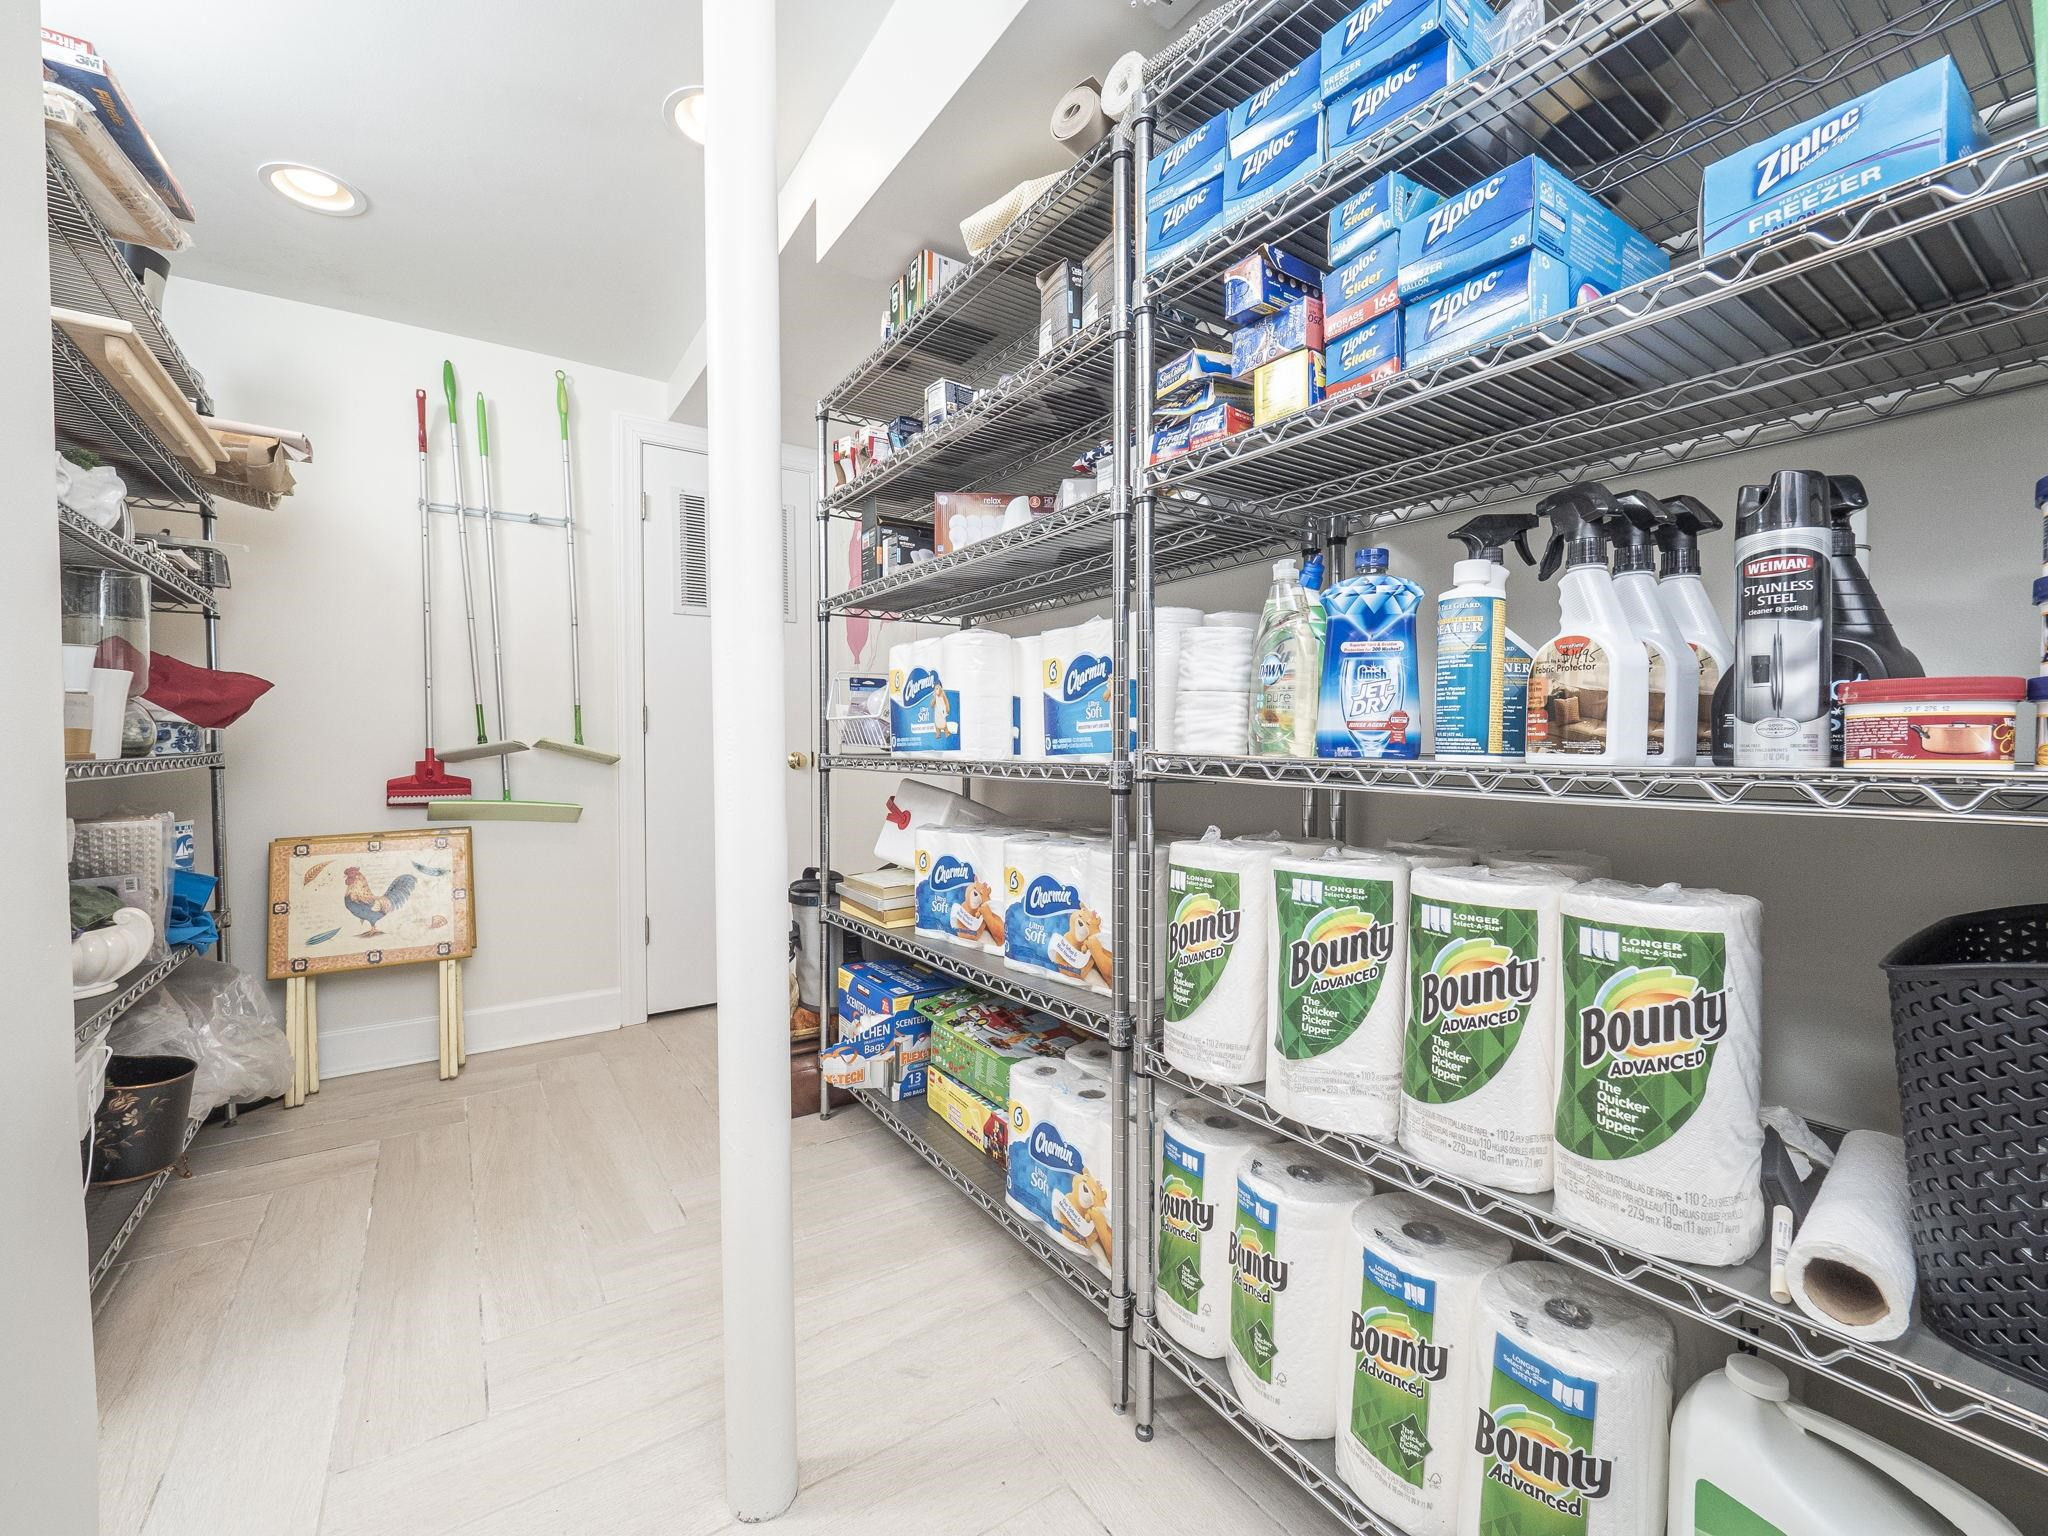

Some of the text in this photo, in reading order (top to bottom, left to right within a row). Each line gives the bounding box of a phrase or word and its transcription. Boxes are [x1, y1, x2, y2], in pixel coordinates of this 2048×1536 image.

[75, 53, 100, 70] 3M
[1324, 59, 1361, 89] FREEZER
[1351, 63, 1418, 128] Ziploc
[1161, 125, 1211, 176] Ziploc
[1240, 130, 1298, 184] Ziploc
[1757, 105, 1862, 196] Ziploc
[1799, 124, 1861, 172] Double Zipper
[1778, 172, 1846, 207] HEAVY DUTY
[1341, 185, 1376, 218] Ziploc
[1749, 165, 1883, 235] FREEZER
[1161, 187, 1211, 234] Ziploc
[1343, 202, 1378, 231] Slider
[1426, 177, 1503, 245] Ziploc
[1509, 233, 1526, 249] 38
[1340, 249, 1378, 288] Ziploc
[1344, 268, 1384, 300] Slider
[1401, 277, 1429, 293] GALLON
[1373, 289, 1397, 310] 166
[1427, 270, 1500, 335] Ziploc
[1326, 307, 1365, 334] STORAGE
[1341, 324, 1378, 361] Ziploc
[1343, 343, 1380, 371] Slider
[983, 496, 1002, 505] relax
[1747, 557, 1809, 576] WEIMAN
[1744, 579, 1814, 597] STAINLESS
[1757, 592, 1798, 606] STEEL
[1748, 604, 1809, 616] cleaner & polish
[1048, 664, 1057, 682] 6
[1066, 660, 1108, 692] Charmin
[1259, 663, 1287, 679] DAWN
[1359, 665, 1387, 681] finish
[1535, 662, 1597, 674] Fabric Protector
[893, 671, 901, 689] 6
[904, 676, 935, 699] Charmin
[1266, 692, 1292, 703] pure
[1350, 696, 1395, 717] DRY
[917, 711, 930, 723] Soft
[1086, 704, 1104, 719] Soft
[919, 852, 928, 869] 6
[934, 863, 970, 885] Charmin
[1009, 871, 1019, 890] 6
[1186, 873, 1213, 884] LONGER
[1029, 886, 1072, 909] Charmin
[1323, 891, 1367, 901] Select-A-Size
[1324, 884, 1366, 895] LONGER
[931, 899, 949, 914] Soft
[1028, 921, 1045, 931] Ultra
[1452, 912, 1500, 925] LONGER
[1452, 920, 1502, 932] Select-A-Size
[1024, 927, 1047, 945] Soft
[1169, 909, 1241, 961] Bounty
[1621, 936, 1683, 952] LONGER
[1178, 947, 1224, 966] ADVANCED
[1290, 922, 1395, 987] Bounty
[1620, 945, 1686, 960] Select-A-Size
[1173, 968, 1185, 979] The
[1173, 976, 1196, 990] Quicker
[1311, 966, 1378, 993] ADVANCED
[1173, 985, 1191, 996] Picker
[1173, 992, 1192, 1005] Upper
[1421, 958, 1540, 1025] Bounty
[846, 994, 867, 1015] SCENTED
[1301, 995, 1321, 1007] The
[1301, 1004, 1340, 1018] Quicker
[1301, 1013, 1333, 1027] Picker
[1441, 1008, 1519, 1033] ADVANCED
[895, 1015, 926, 1028] SCENTED
[1301, 1022, 1336, 1037] Upper
[1580, 987, 1729, 1069] Bounty
[843, 1023, 891, 1045] KITCHEN
[1431, 1034, 1450, 1049] The
[864, 1042, 885, 1055] Bags
[1431, 1044, 1472, 1064] Quicker
[1431, 1054, 1464, 1073] Picker
[1610, 1048, 1706, 1078] ADVANCED
[908, 1072, 922, 1084] 13
[1431, 1064, 1463, 1083] Upper
[913, 1088, 926, 1097] BAGS
[1596, 1078, 1622, 1095] The
[1596, 1090, 1650, 1116] Quicker
[1013, 1107, 1023, 1128] 6
[1596, 1102, 1639, 1124] Picker
[1596, 1113, 1639, 1136] Upper
[1496, 1129, 1509, 1142] 110
[1034, 1130, 1074, 1168] Charmin
[1479, 1149, 1488, 1161] 18
[1030, 1172, 1050, 1195] Soft
[1684, 1192, 1700, 1206] 110
[1627, 1204, 1673, 1229] 27.9 18
[1374, 1264, 1397, 1280] LONGER
[1350, 1310, 1449, 1382] Bounty
[1502, 1353, 1549, 1386] Select-A-Size
[1511, 1353, 1541, 1375] LONGER
[1358, 1357, 1425, 1400] Advanced
[1511, 1367, 1537, 1387] SHEETS
[1400, 1430, 1426, 1448] Quicker
[1401, 1423, 1415, 1436] The
[1474, 1406, 1613, 1499] Bounty
[1487, 1463, 1582, 1517] Advanced
